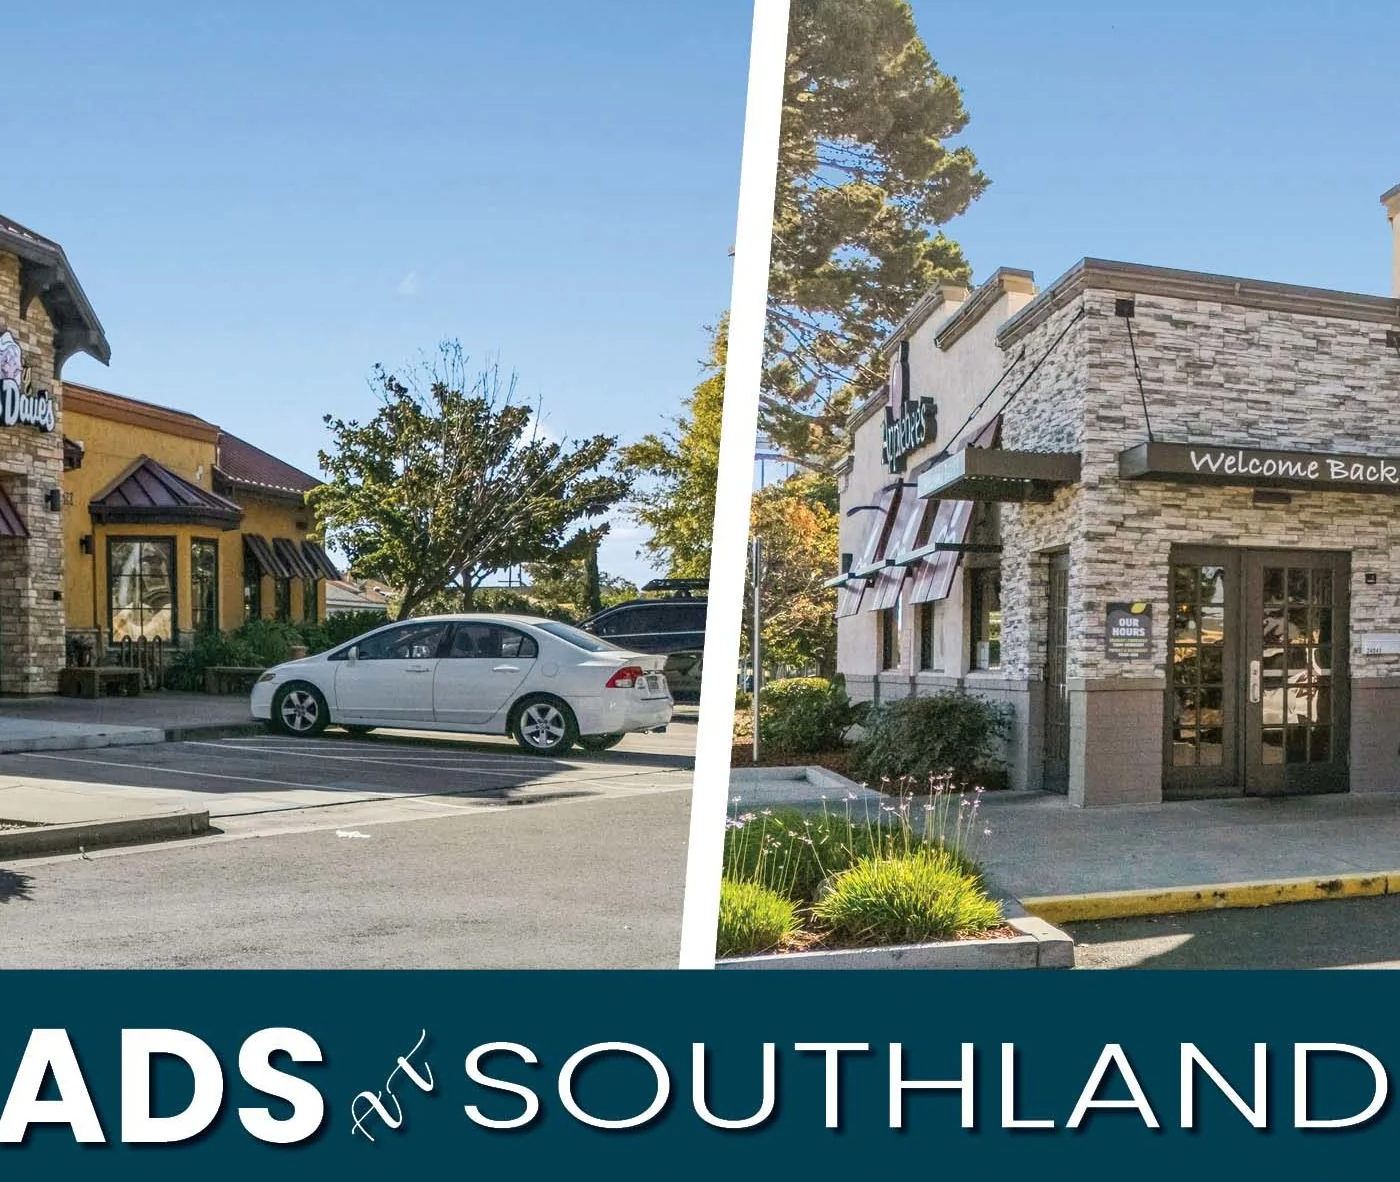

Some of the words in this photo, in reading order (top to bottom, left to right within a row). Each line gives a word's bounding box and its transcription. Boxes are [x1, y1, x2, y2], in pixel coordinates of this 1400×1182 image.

[2, 378, 55, 432] Dave's
[1190, 450, 1319, 479] Welcome
[1112, 628, 1145, 636] HOURS
[1119, 618, 1139, 627] OUR
